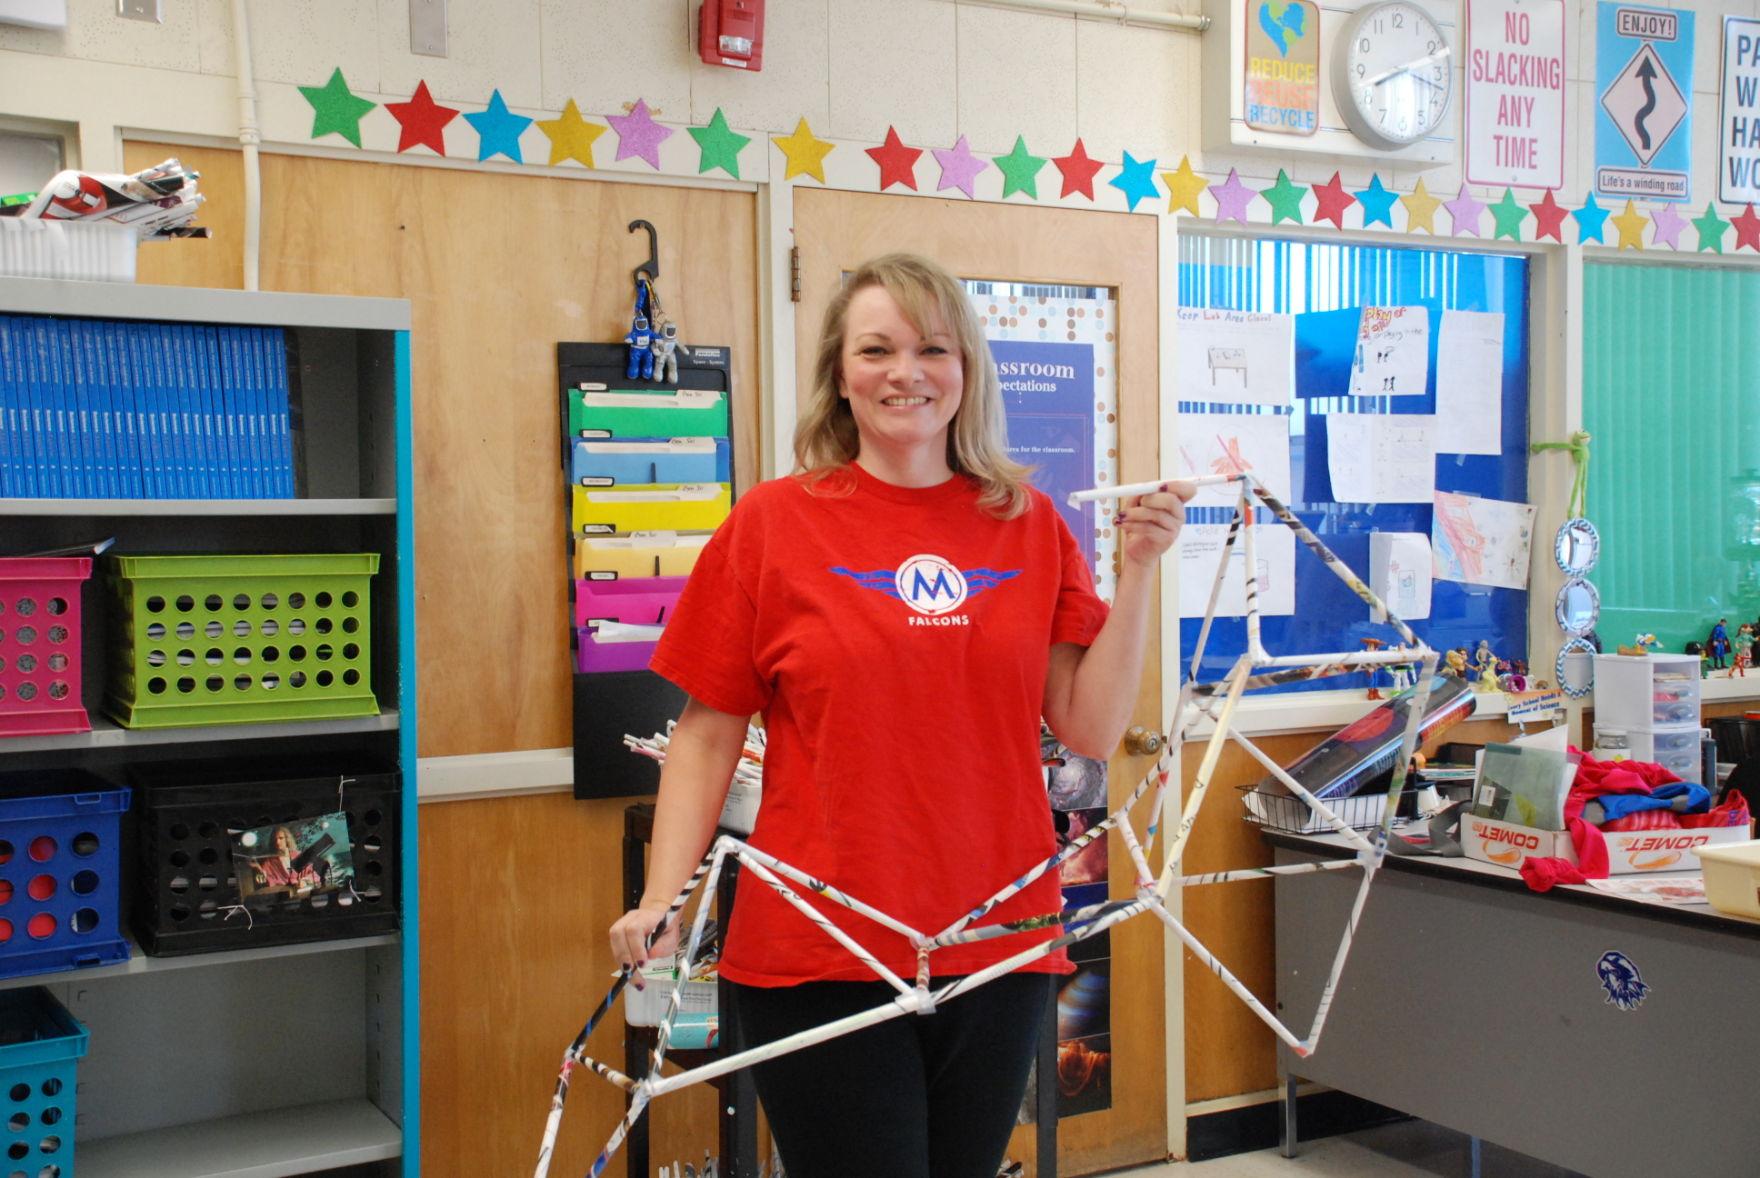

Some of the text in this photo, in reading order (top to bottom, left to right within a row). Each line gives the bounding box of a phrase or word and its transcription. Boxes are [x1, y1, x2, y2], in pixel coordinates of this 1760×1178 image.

[1374, 19, 1383, 34] 11
[1392, 13, 1403, 29] 12
[1505, 11, 1530, 46] NO
[1622, 14, 1672, 35] ENJOY!
[1360, 38, 1370, 53] 10
[1427, 40, 1436, 55] 2
[1250, 56, 1315, 85] REDUCE
[1357, 64, 1365, 78] 9
[1434, 66, 1443, 81] 3
[1473, 48, 1560, 91] SLACKING
[1364, 89, 1372, 104] 8
[1429, 91, 1438, 107] 4
[1249, 104, 1315, 129] RECYCLE
[1378, 109, 1387, 124] 7
[1418, 110, 1425, 126] 5
[1497, 94, 1535, 128] ANY
[1493, 134, 1538, 170] TIME
[1602, 175, 1684, 192] Life's a winding road
[908, 614, 970, 626] FALCONS
[1479, 826, 1539, 850] COMET
[1626, 836, 1709, 851] COMET
